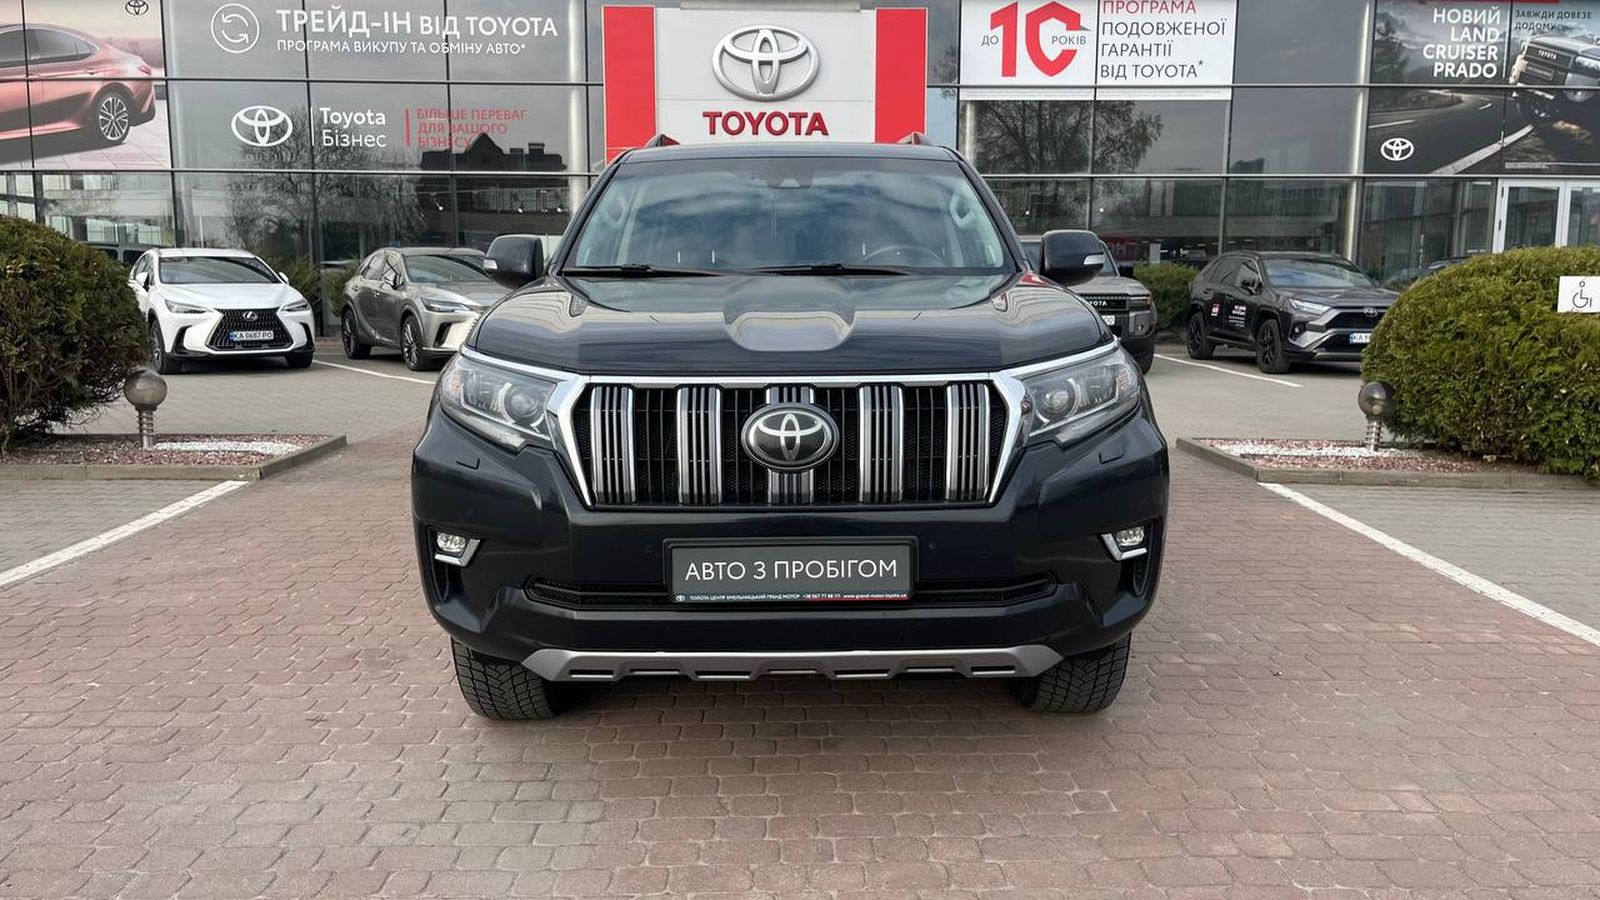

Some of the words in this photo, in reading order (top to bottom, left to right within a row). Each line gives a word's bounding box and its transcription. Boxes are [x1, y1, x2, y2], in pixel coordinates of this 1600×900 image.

[1103, 0, 1197, 14] ПРОГРАМА
[1515, 10, 1555, 19] ЗАВЖДИ
[276, 4, 411, 38] ТРЕЙД-ІН
[419, 15, 460, 39] ВІД
[464, 16, 559, 36] TOYOTA
[1433, 6, 1500, 25] НОВИЙ
[1102, 18, 1228, 38] ПОДОВЖЕНОЇ
[1450, 26, 1500, 42] LAND
[1514, 22, 1556, 31] ДОДОМУ
[277, 39, 351, 53] ПРОГРАМА
[354, 40, 408, 53] ВИКУПУ
[410, 41, 427, 53] ТА
[429, 42, 483, 54] ОБМІНУ
[981, 35, 999, 46] ДО
[1051, 35, 1087, 46] РОКІВ
[1101, 39, 1174, 57] ГАРАНТІЇ
[1423, 43, 1498, 60] CRUISER
[1100, 64, 1127, 80] ВІД
[1433, 62, 1497, 78] PRADO
[319, 107, 386, 129] Toyota
[417, 108, 467, 120] БІЛЬШЕ
[471, 109, 528, 121] ПЕРЕВАГ
[418, 122, 445, 135] ДЛЯ
[451, 123, 508, 134] ВАШОГО
[702, 110, 829, 136] TOYOTA
[322, 129, 387, 147] Бізнес
[685, 561, 746, 580] АВТО
[774, 559, 897, 579] ПРОБІГОМ
